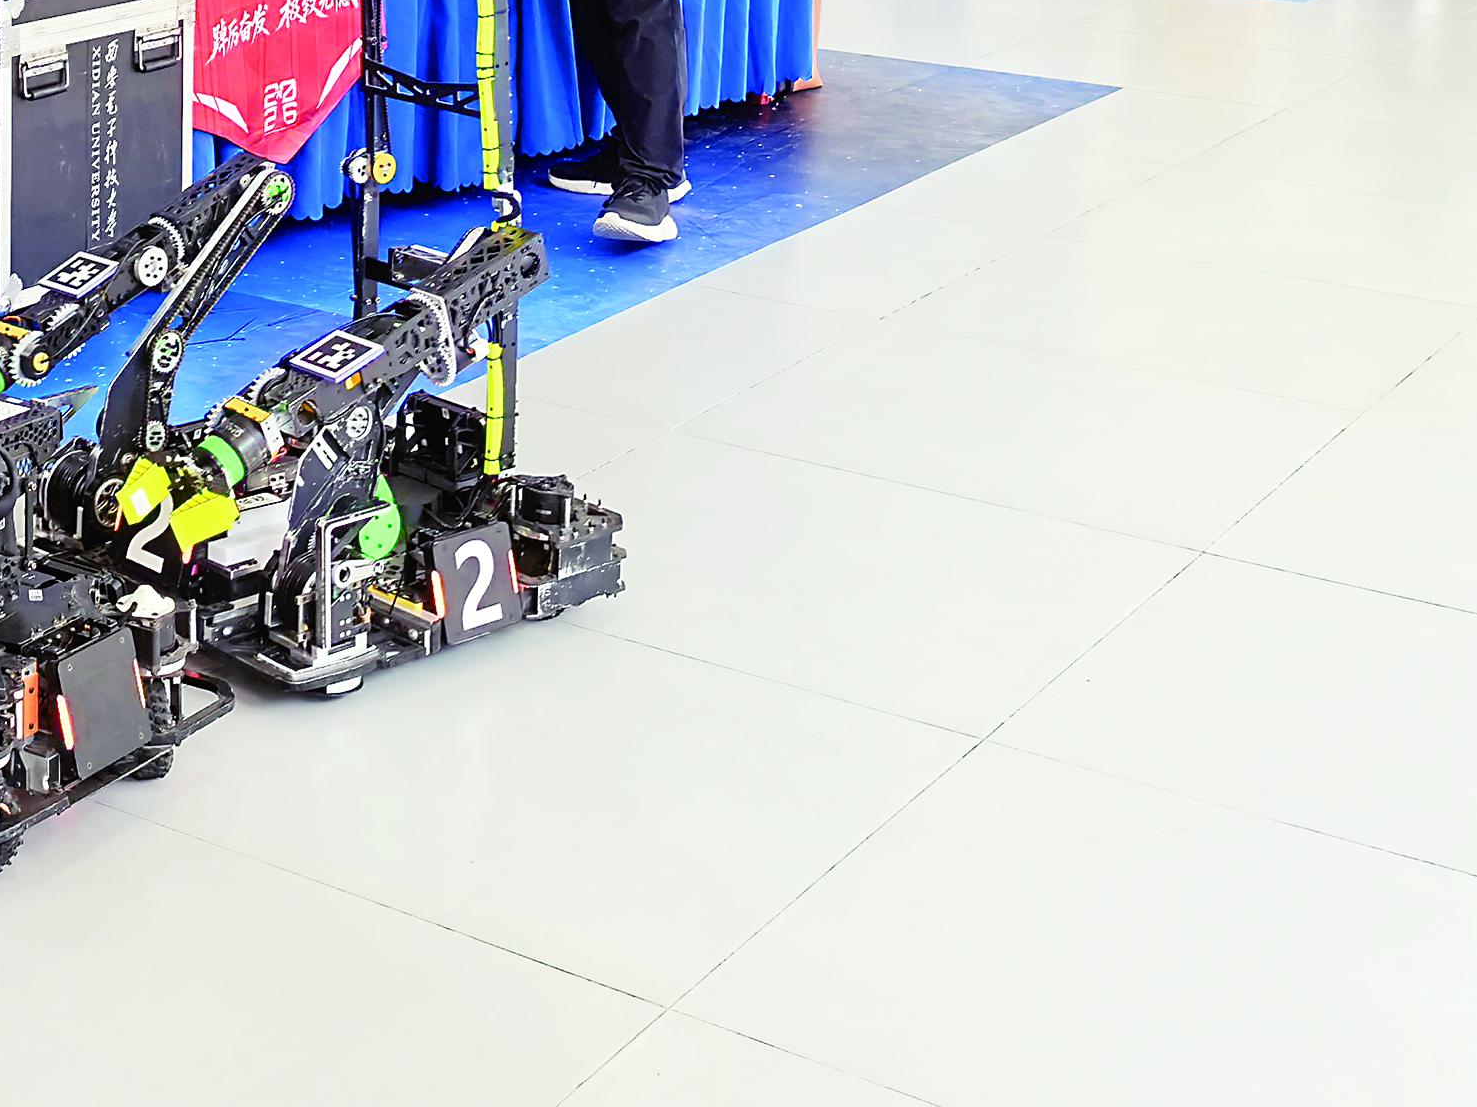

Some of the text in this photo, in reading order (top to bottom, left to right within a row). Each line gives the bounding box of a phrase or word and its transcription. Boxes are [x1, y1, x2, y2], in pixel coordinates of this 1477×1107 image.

[90, 45, 102, 242] XIDIAN UNIVERSITY
[453, 538, 505, 632] 2
